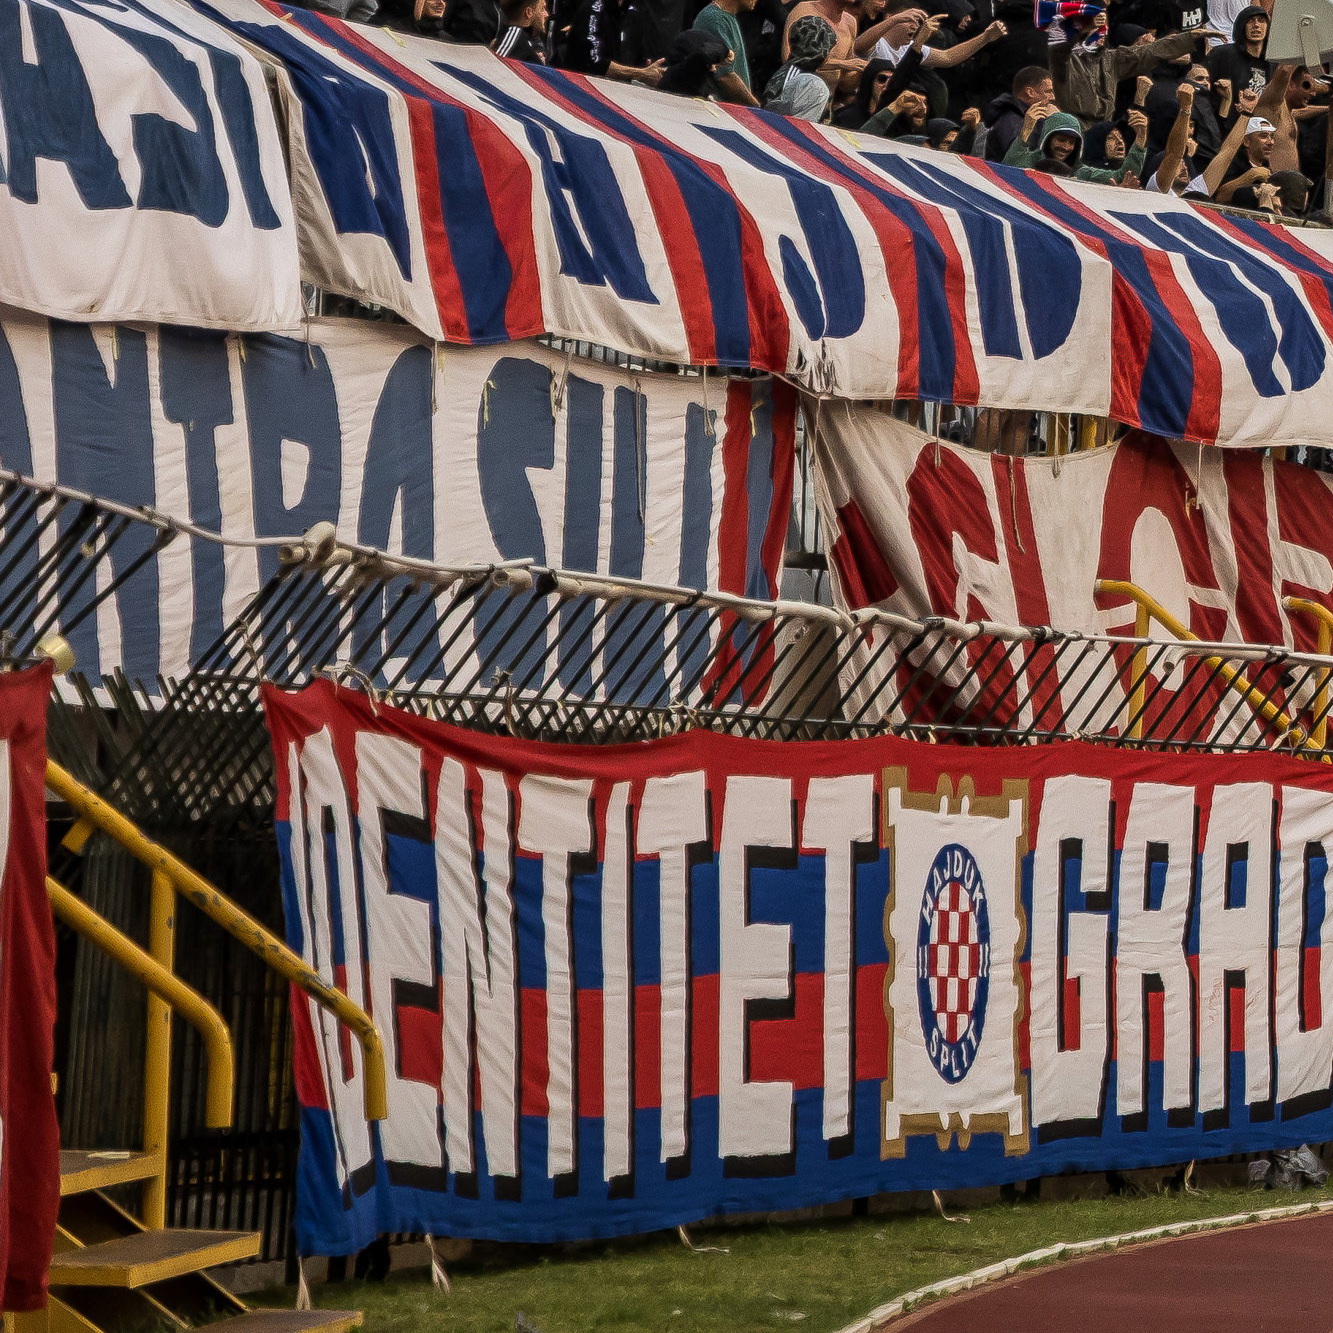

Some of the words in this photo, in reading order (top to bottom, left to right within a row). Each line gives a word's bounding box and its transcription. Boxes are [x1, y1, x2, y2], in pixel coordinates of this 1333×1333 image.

[922, 850, 985, 927] HAJDUK
[288, 724, 876, 1192] IDENTITET
[930, 1019, 978, 1078] SPLIT
